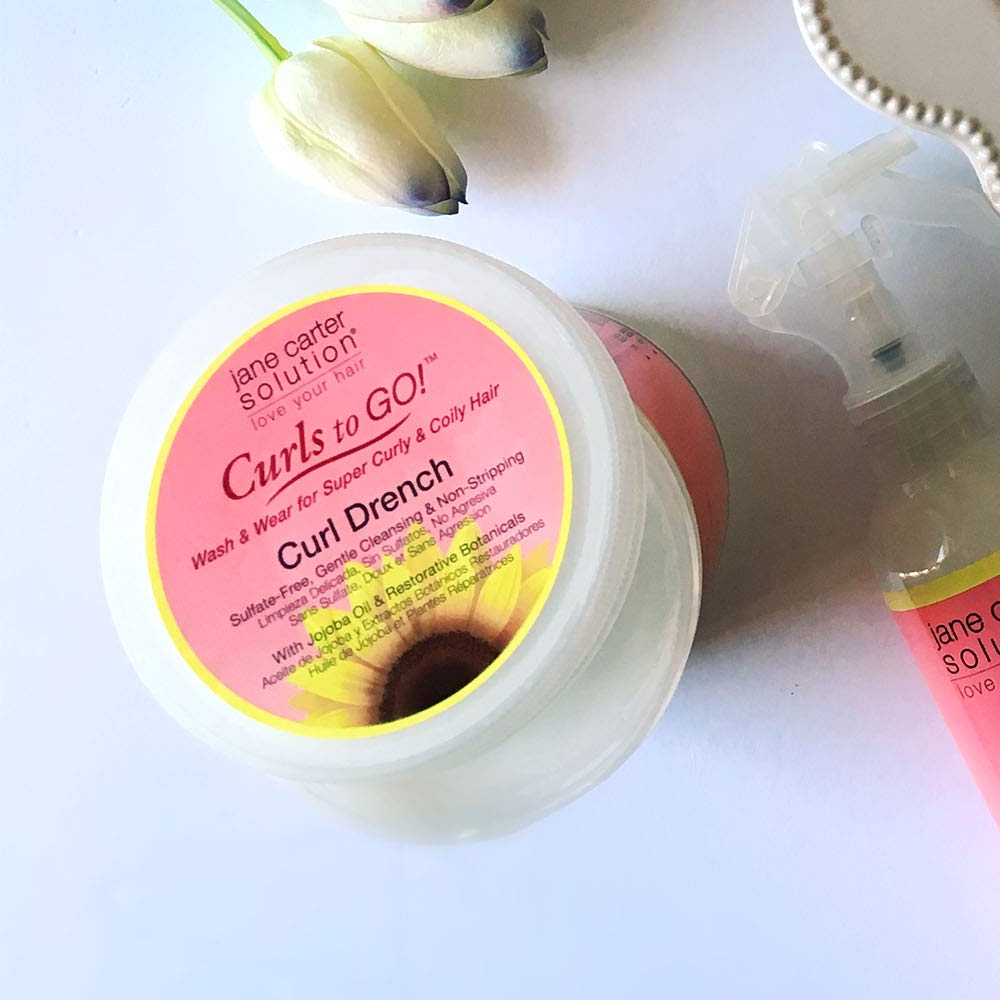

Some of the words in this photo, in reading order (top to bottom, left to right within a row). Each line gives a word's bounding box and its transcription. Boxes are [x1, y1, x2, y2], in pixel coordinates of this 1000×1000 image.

[228, 351, 279, 393] jane
[283, 310, 345, 358] carter
[190, 537, 234, 570] Wash
[238, 528, 250, 545] &
[252, 504, 293, 536] Wear
[296, 489, 319, 512] for
[322, 461, 368, 496] Super
[371, 436, 411, 467] Curly
[415, 426, 426, 443] &
[429, 403, 466, 434] Coily
[469, 383, 500, 411] Hair
[221, 419, 325, 500] Curls
[332, 413, 359, 444] to
[277, 517, 341, 570] Curl
[343, 457, 454, 532] Drench
[314, 548, 358, 578] Gentle
[358, 510, 424, 552] Cleansing
[424, 501, 436, 515] &
[435, 450, 525, 508] Non-Stripping
[927, 611, 985, 651] jane
